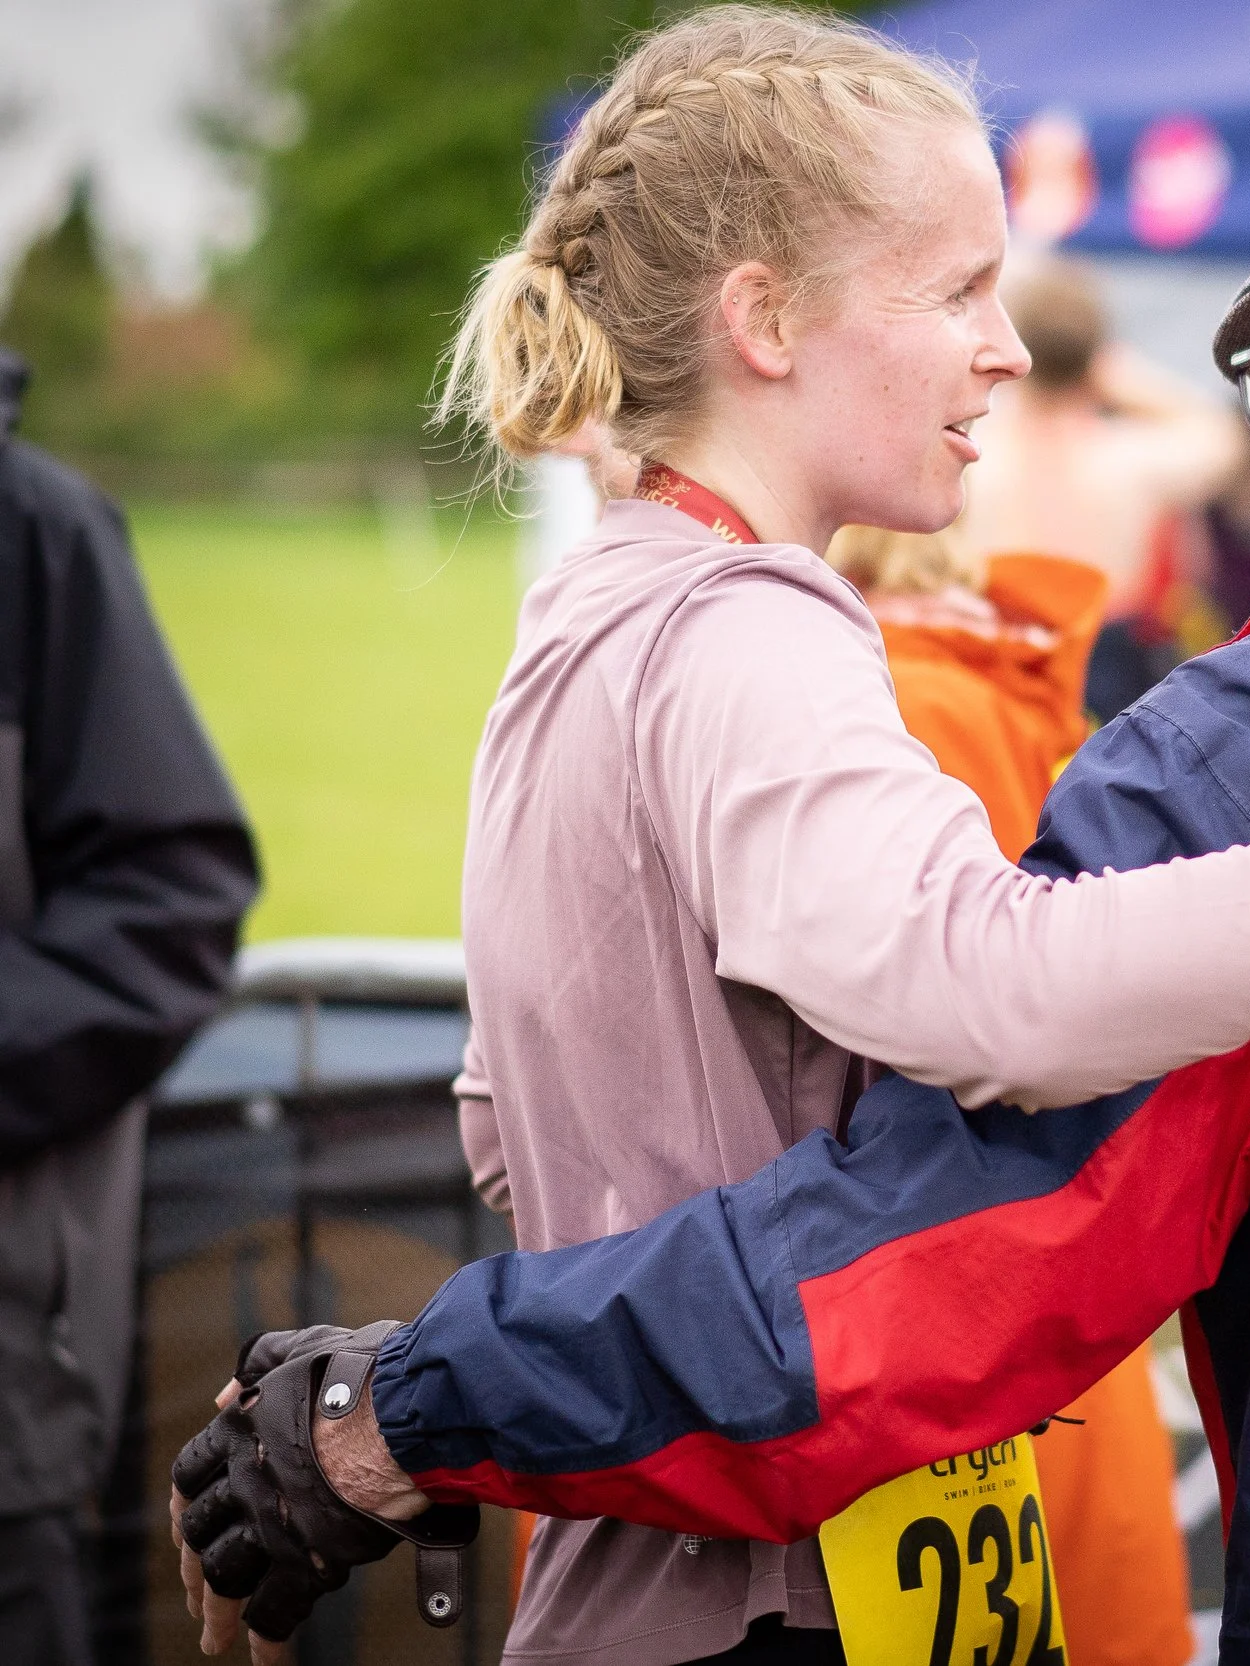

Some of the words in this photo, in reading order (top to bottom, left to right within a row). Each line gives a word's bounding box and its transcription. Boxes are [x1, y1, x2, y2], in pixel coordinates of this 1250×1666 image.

[944, 1489, 968, 1500] SWIM
[979, 1483, 996, 1493] BIKE
[1004, 1478, 1016, 1488] RUN
[897, 1493, 1065, 1666] 232
